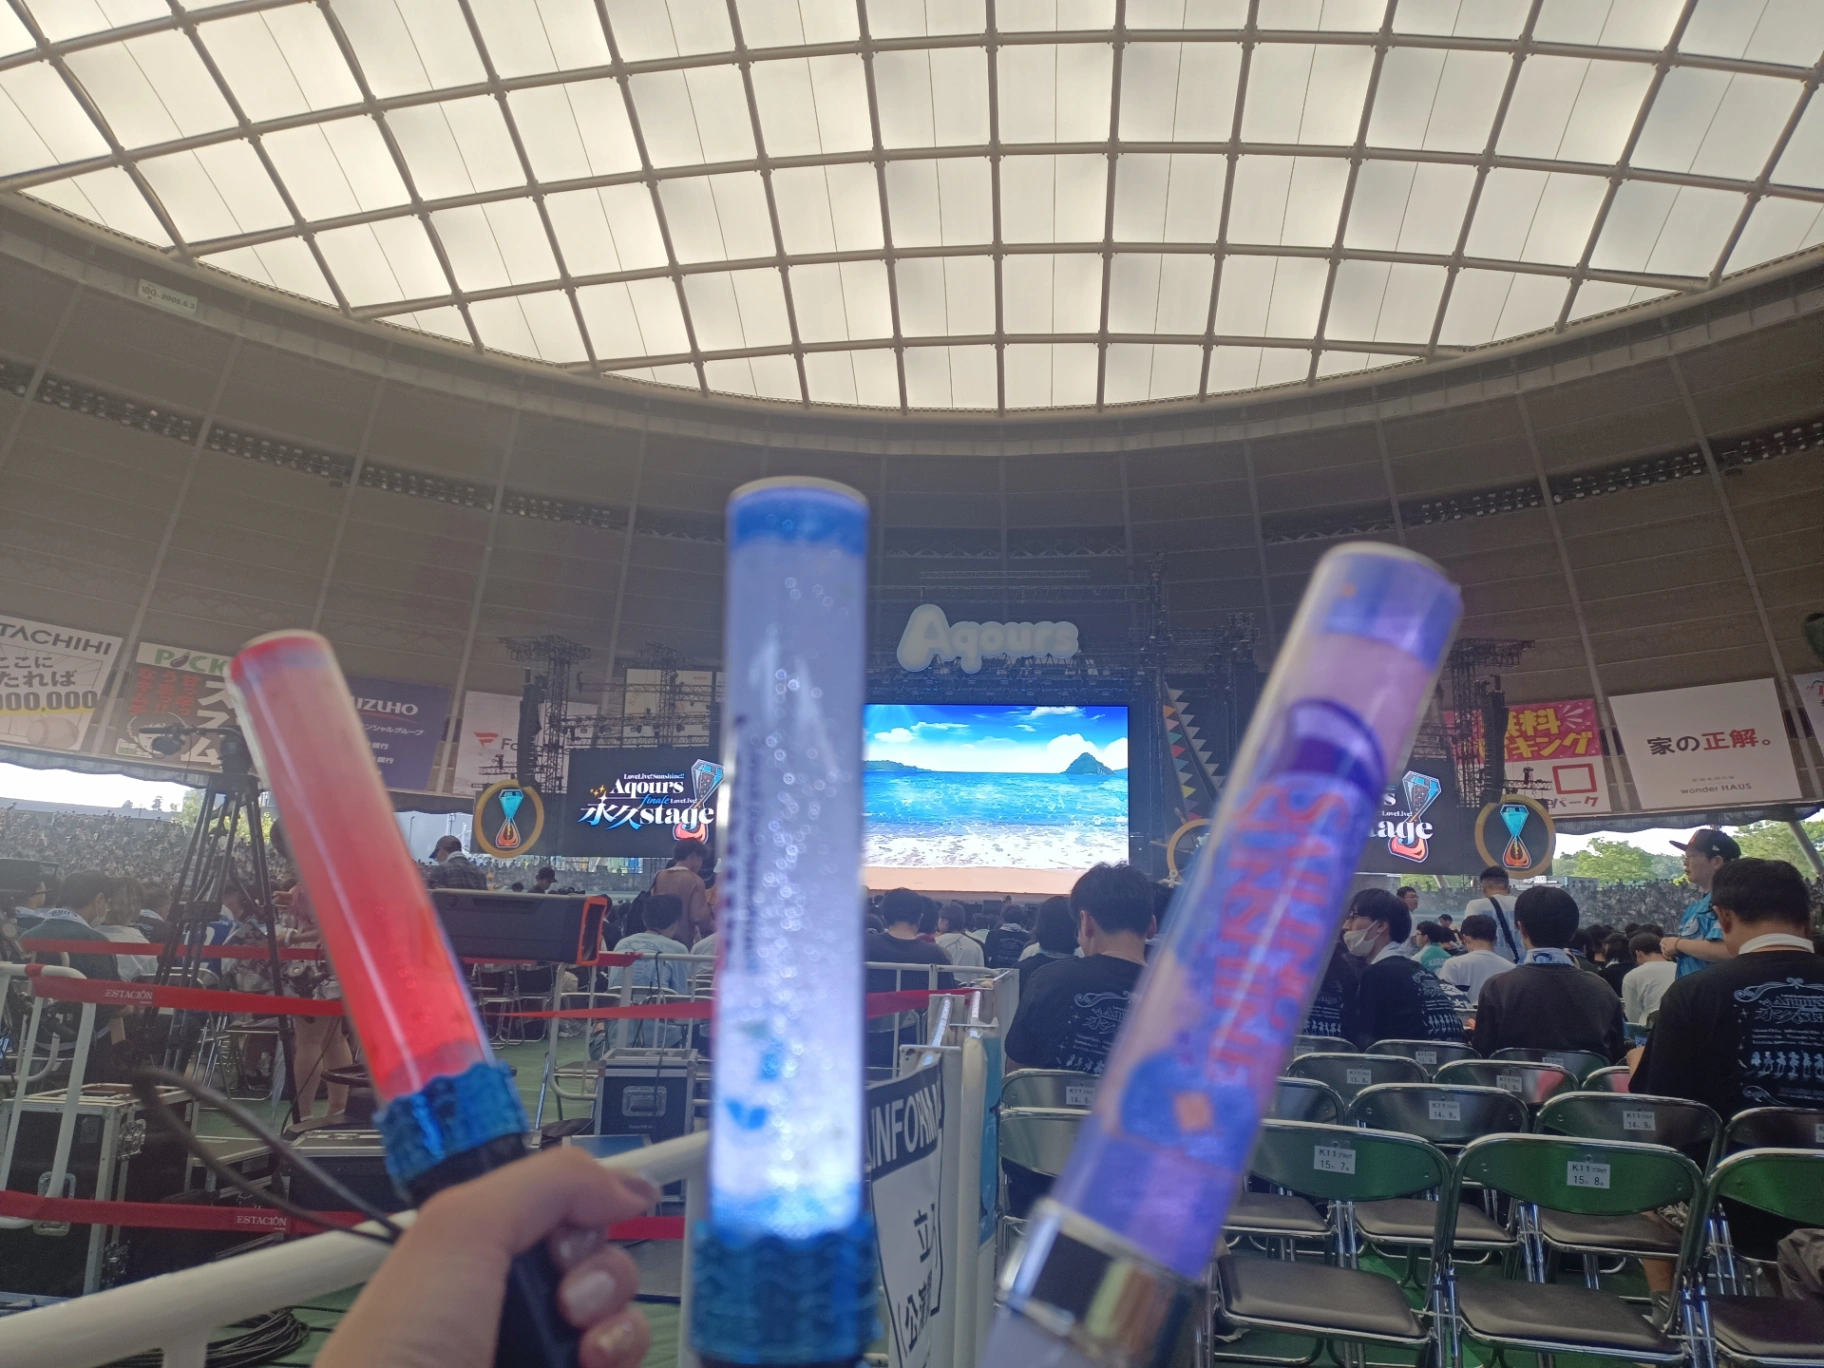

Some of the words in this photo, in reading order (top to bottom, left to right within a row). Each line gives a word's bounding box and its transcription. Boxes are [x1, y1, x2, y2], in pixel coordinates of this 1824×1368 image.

[897, 603, 1079, 675] Aqours
[352, 697, 418, 715] IZUHO
[1505, 731, 1593, 758] キング
[1646, 728, 1771, 756] 家の正解。
[609, 778, 684, 799] Aqours
[1680, 785, 1718, 794] wonder
[1720, 782, 1752, 792] HAUS
[637, 794, 671, 809] finale
[105, 989, 153, 1000] ESTACIÓN
[237, 1215, 287, 1226] ESTACIÓN
